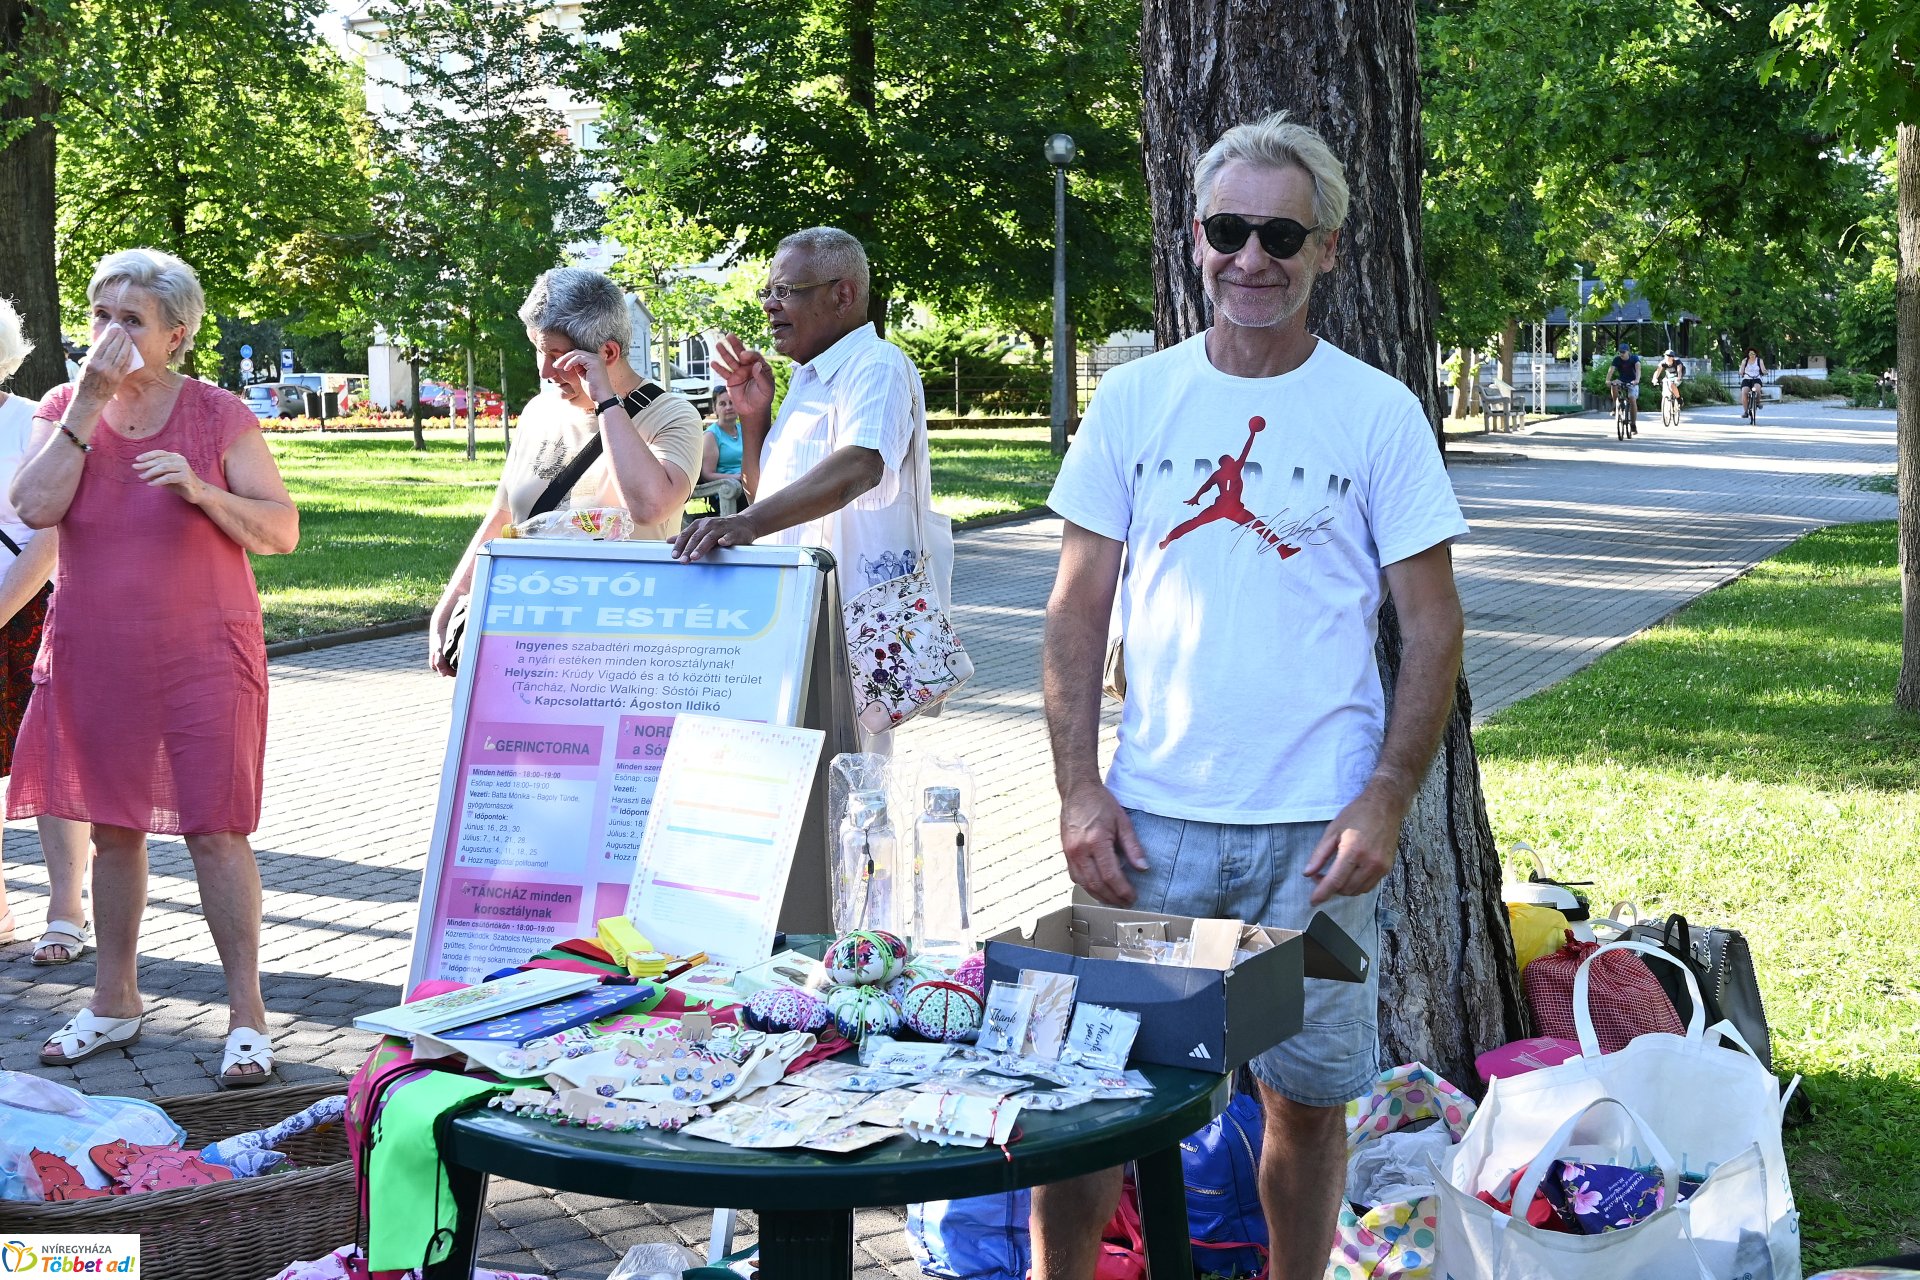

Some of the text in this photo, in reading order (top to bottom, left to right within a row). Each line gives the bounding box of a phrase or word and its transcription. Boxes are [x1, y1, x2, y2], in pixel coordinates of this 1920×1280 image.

[490, 572, 656, 597] SÓSTÓI
[486, 604, 750, 630] FITT ESTÉK
[515, 640, 741, 657] Ingyenes szabadtéri mozgásprogramok
[517, 654, 735, 671] a nyári estéken minden korosztálynak!
[505, 668, 558, 681] Helyszín:
[562, 669, 594, 682] Krúdy
[598, 669, 637, 682] Vigadó
[640, 671, 654, 681] és
[668, 671, 679, 682] tó
[683, 672, 721, 683] közötti
[724, 673, 763, 685] terület
[512, 682, 732, 699] (Táncház, Nordic Walking: Sóstói Piac)
[534, 695, 721, 712] Kapcsolattartó: Ágoston Ildikó
[495, 739, 590, 755] GERINCTORNA
[633, 746, 640, 755] a
[616, 763, 642, 771] Minden
[496, 780, 511, 788] kedd
[613, 785, 637, 793] Vezeti:
[469, 790, 490, 798] Vezeti:
[474, 812, 509, 821] Időpontok:
[609, 819, 633, 827] Június:
[607, 830, 630, 838] Július:
[613, 853, 631, 861] Hozz
[472, 885, 572, 903] TÁNCHÁZ minden
[474, 903, 552, 919] korosztálynak
[447, 919, 470, 927] Minden
[464, 954, 472, 962] és
[487, 956, 505, 964] sokan
[990, 1008, 1017, 1023] Thank
[1089, 1022, 1113, 1052] Thank
